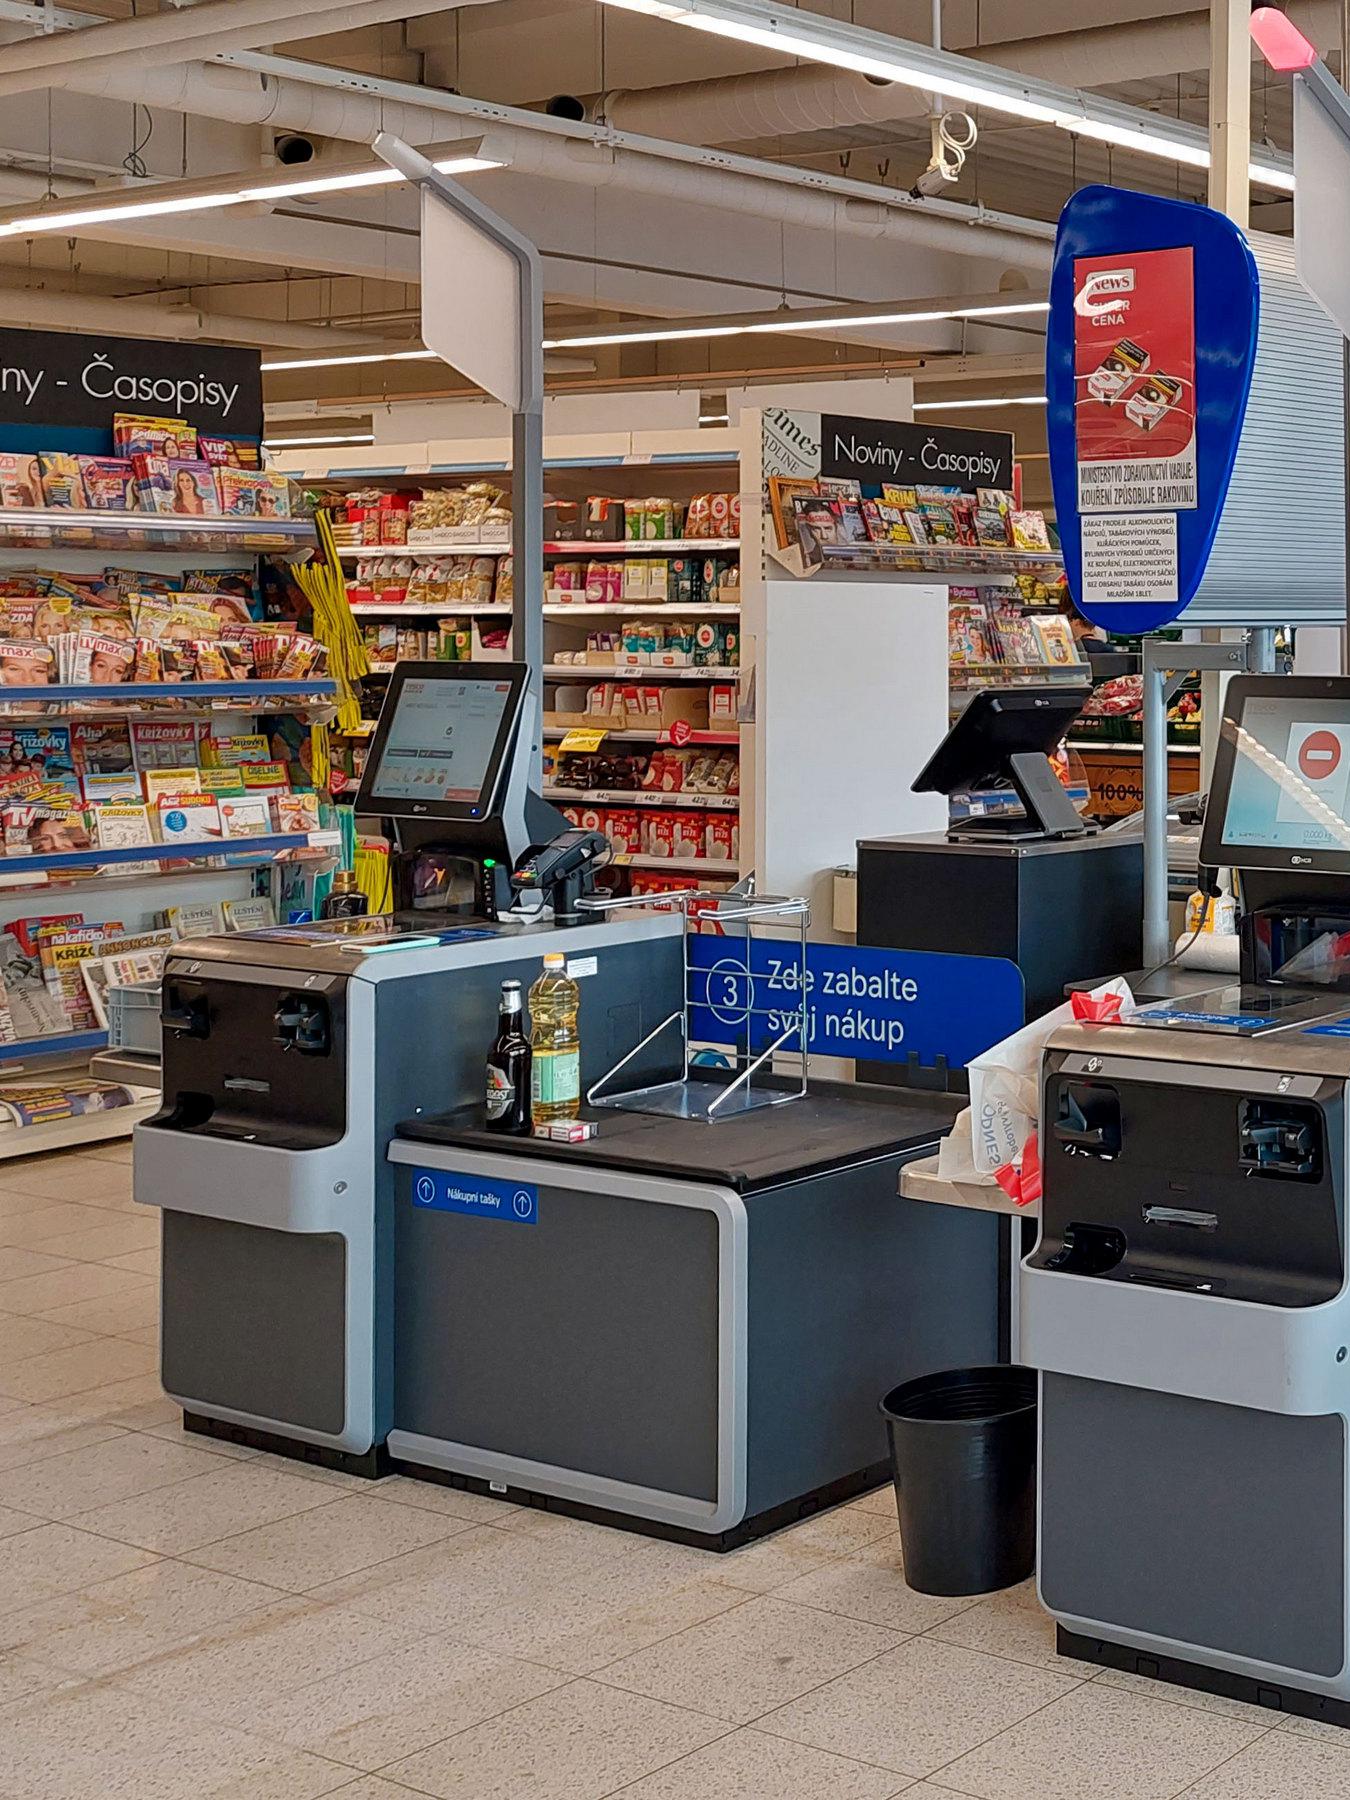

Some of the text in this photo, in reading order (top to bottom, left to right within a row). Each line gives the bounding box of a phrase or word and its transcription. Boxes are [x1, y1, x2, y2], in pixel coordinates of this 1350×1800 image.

[1092, 315, 1125, 327] CENA
[81, 353, 239, 417] Časopisy
[834, 434, 903, 474] Noviny
[921, 437, 1001, 482] Časopisy
[1080, 461, 1194, 484] MINISTERSTVO ZDRAVOTNICTVÍ VARUJE:
[1080, 484, 1194, 506] KOUŘENÍ ZPŮSOBUJE RAKOVINU
[2, 646, 33, 658] max
[97, 640, 121, 655] max
[722, 976, 739, 1007] 3
[768, 960, 918, 1001] Zde zabalte
[768, 1003, 904, 1050] svůj nákup
[447, 1187, 501, 1209] Nákupní tašky
